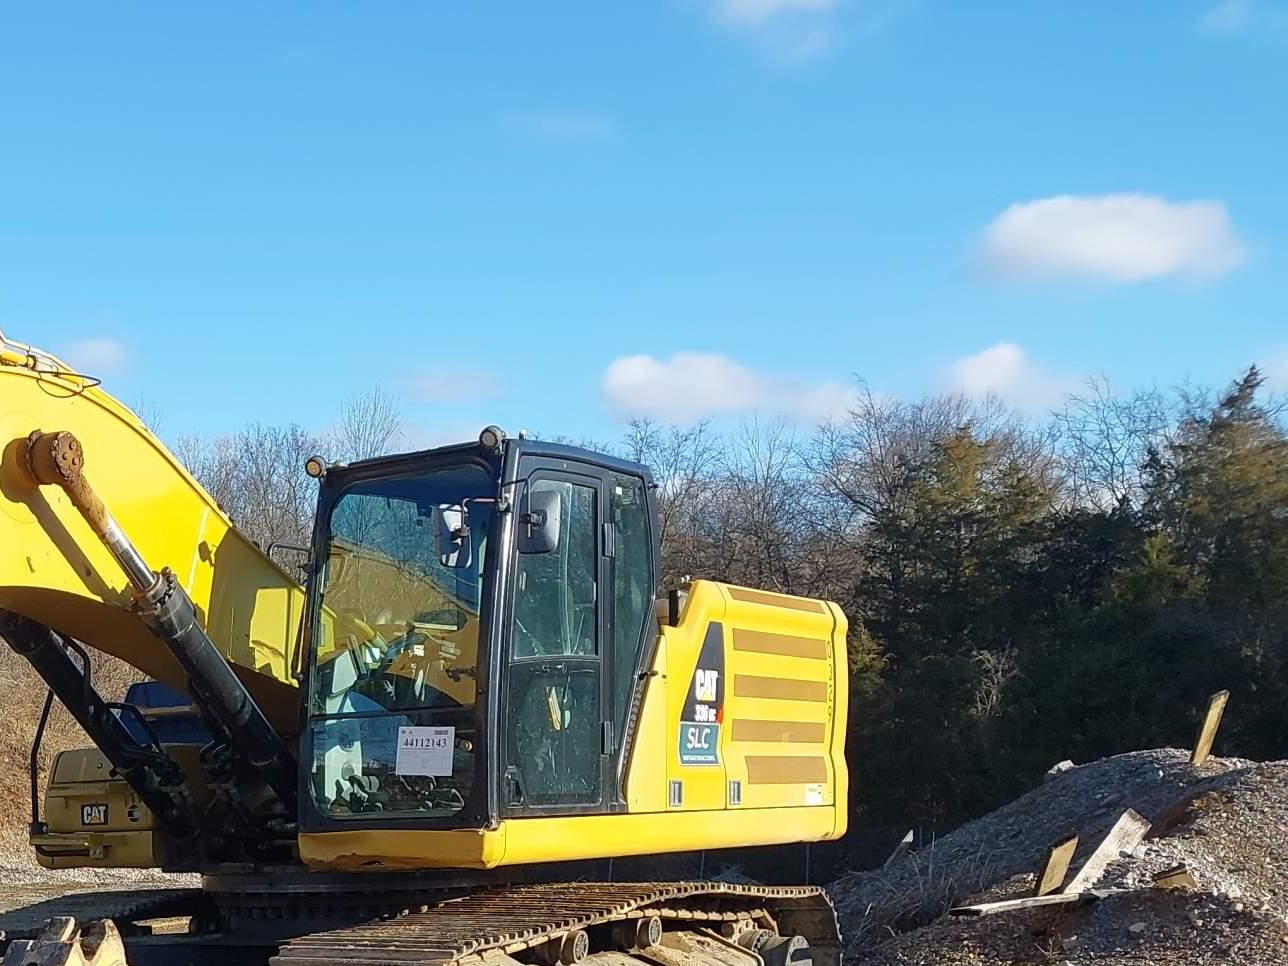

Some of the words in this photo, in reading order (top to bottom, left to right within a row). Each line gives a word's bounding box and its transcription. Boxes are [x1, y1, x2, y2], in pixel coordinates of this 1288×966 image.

[695, 669, 718, 702] CAT
[695, 704, 709, 722] 336
[403, 738, 447, 748] 44112143
[687, 728, 710, 749] SLC
[83, 806, 106, 824] CAT
